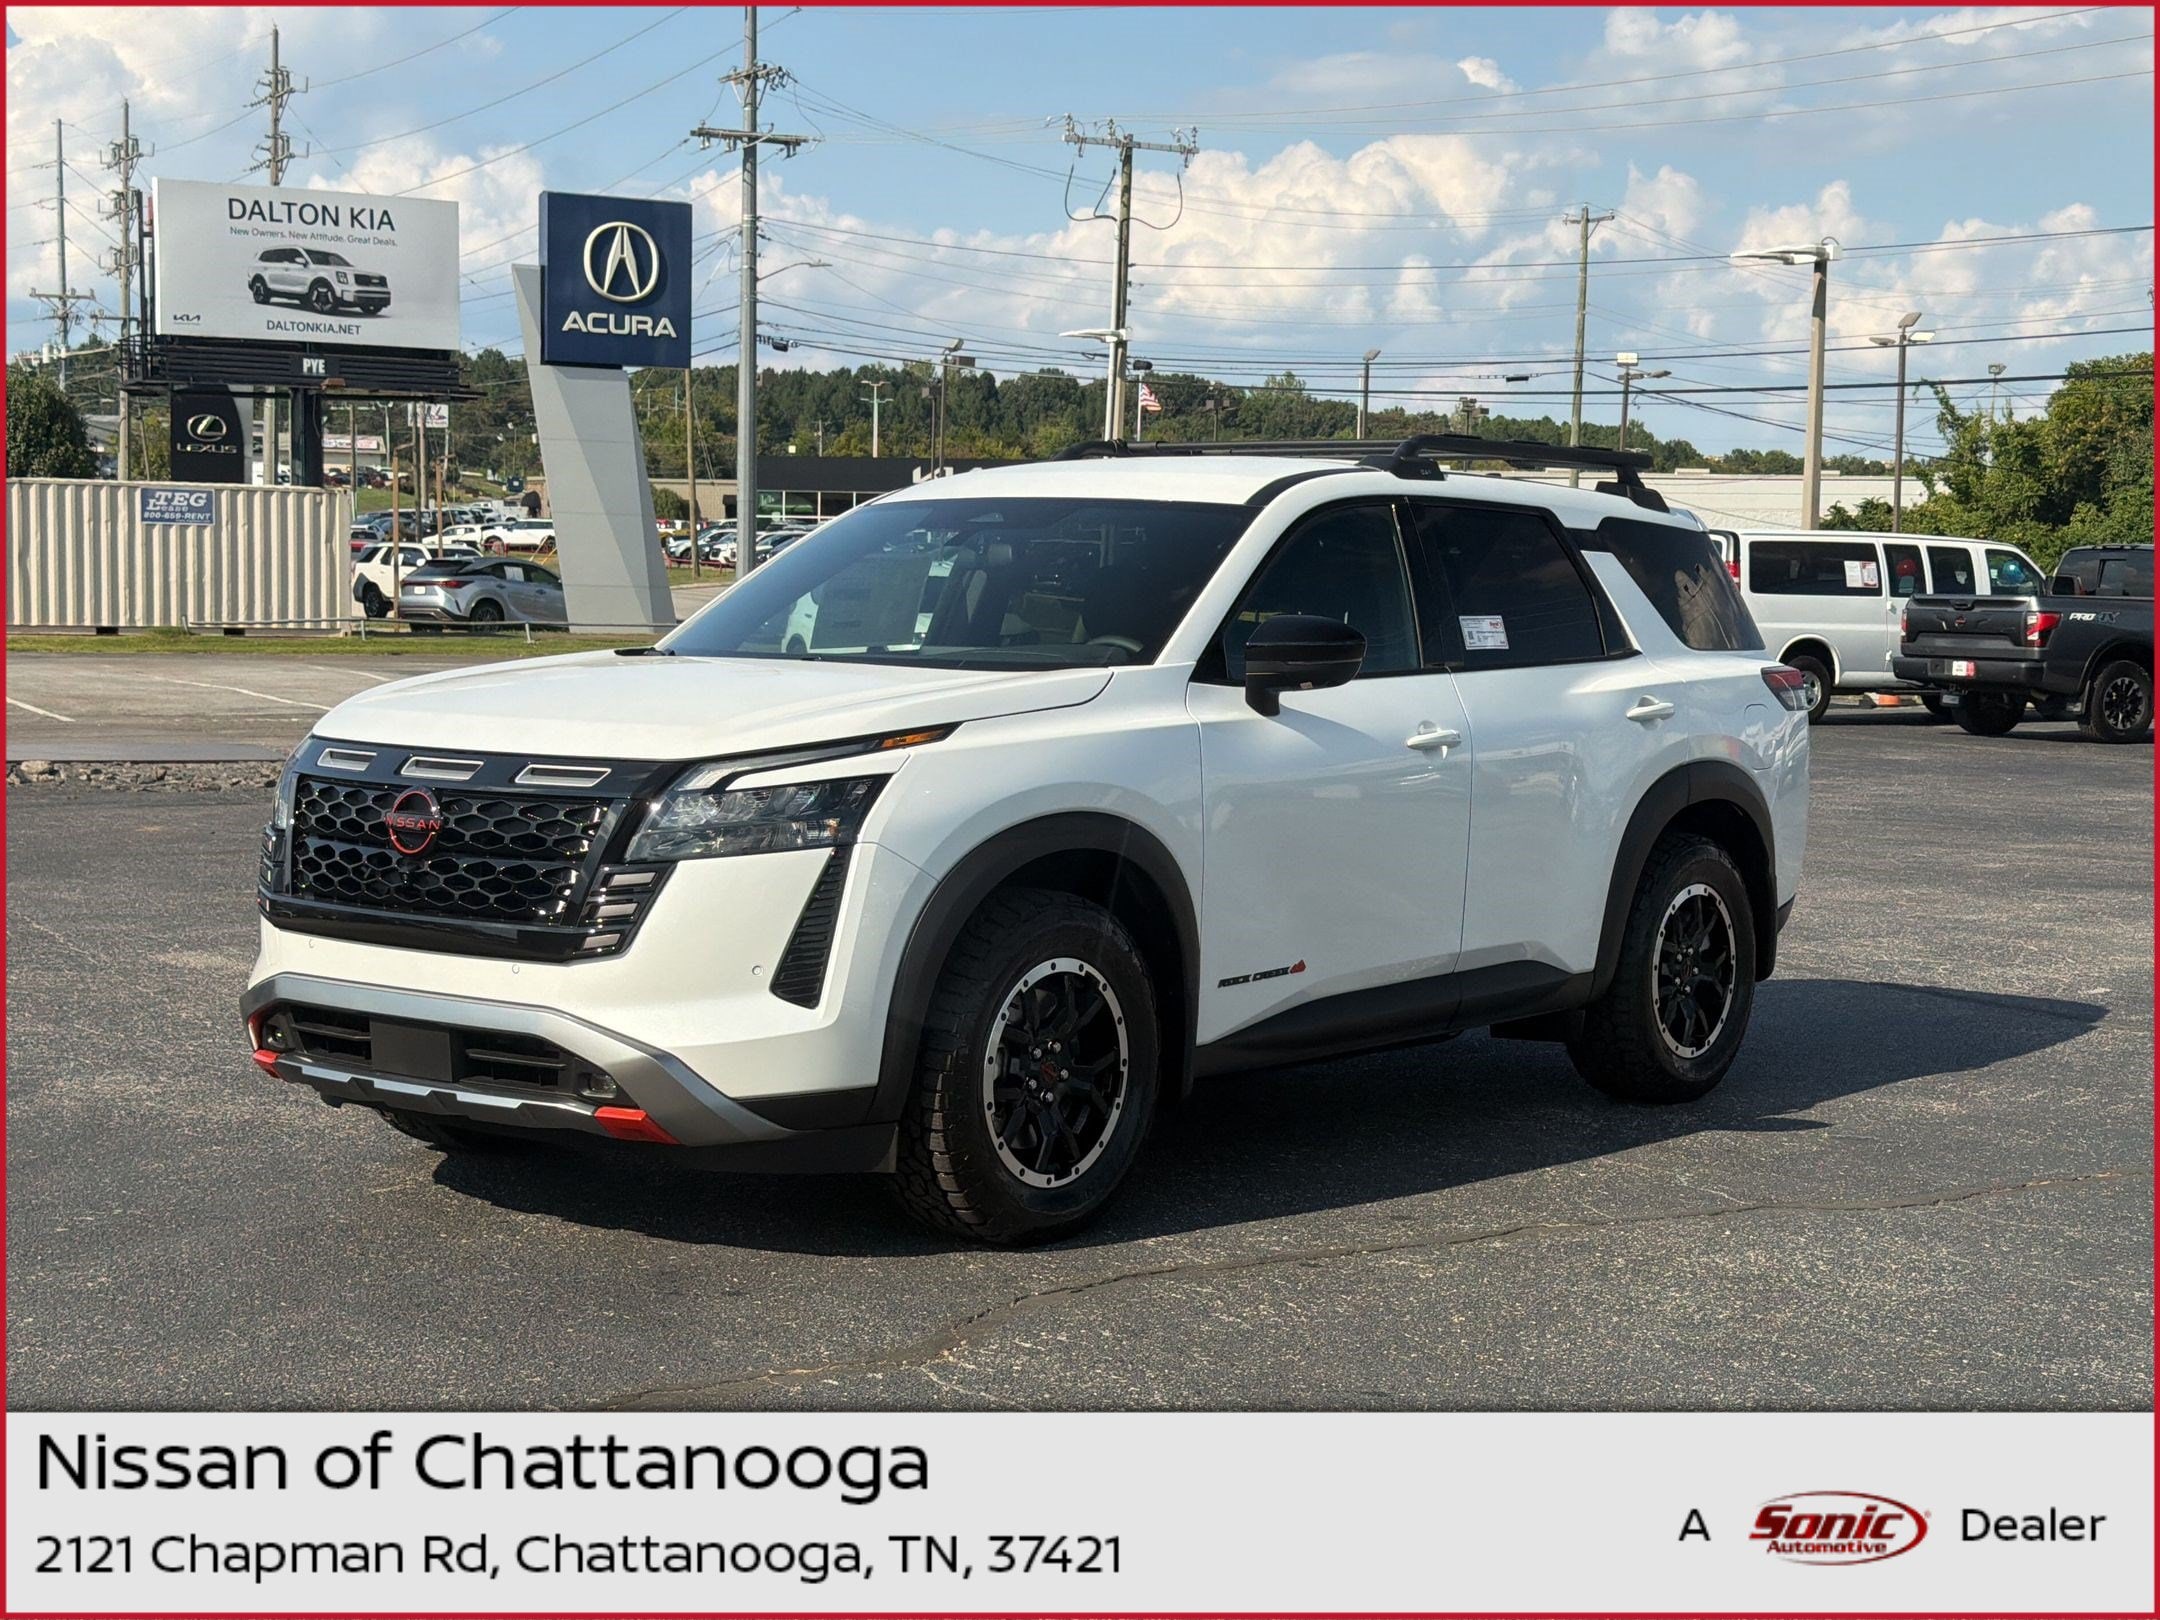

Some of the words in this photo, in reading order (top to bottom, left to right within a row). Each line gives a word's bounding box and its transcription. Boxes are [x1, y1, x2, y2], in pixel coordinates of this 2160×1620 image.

[228, 198, 340, 227] DALTON
[350, 207, 396, 232] KIA
[230, 226, 249, 236] New
[252, 228, 286, 238] Owners.
[289, 231, 308, 240] New
[310, 233, 345, 243] Attitude.
[347, 235, 371, 245] Great
[266, 319, 362, 335] DALTONKIA.NET
[562, 311, 678, 338] ACURA
[303, 357, 325, 374] PYE
[177, 443, 237, 454] LEXUS
[155, 491, 207, 507] TEG
[386, 816, 441, 830] NISSAN
